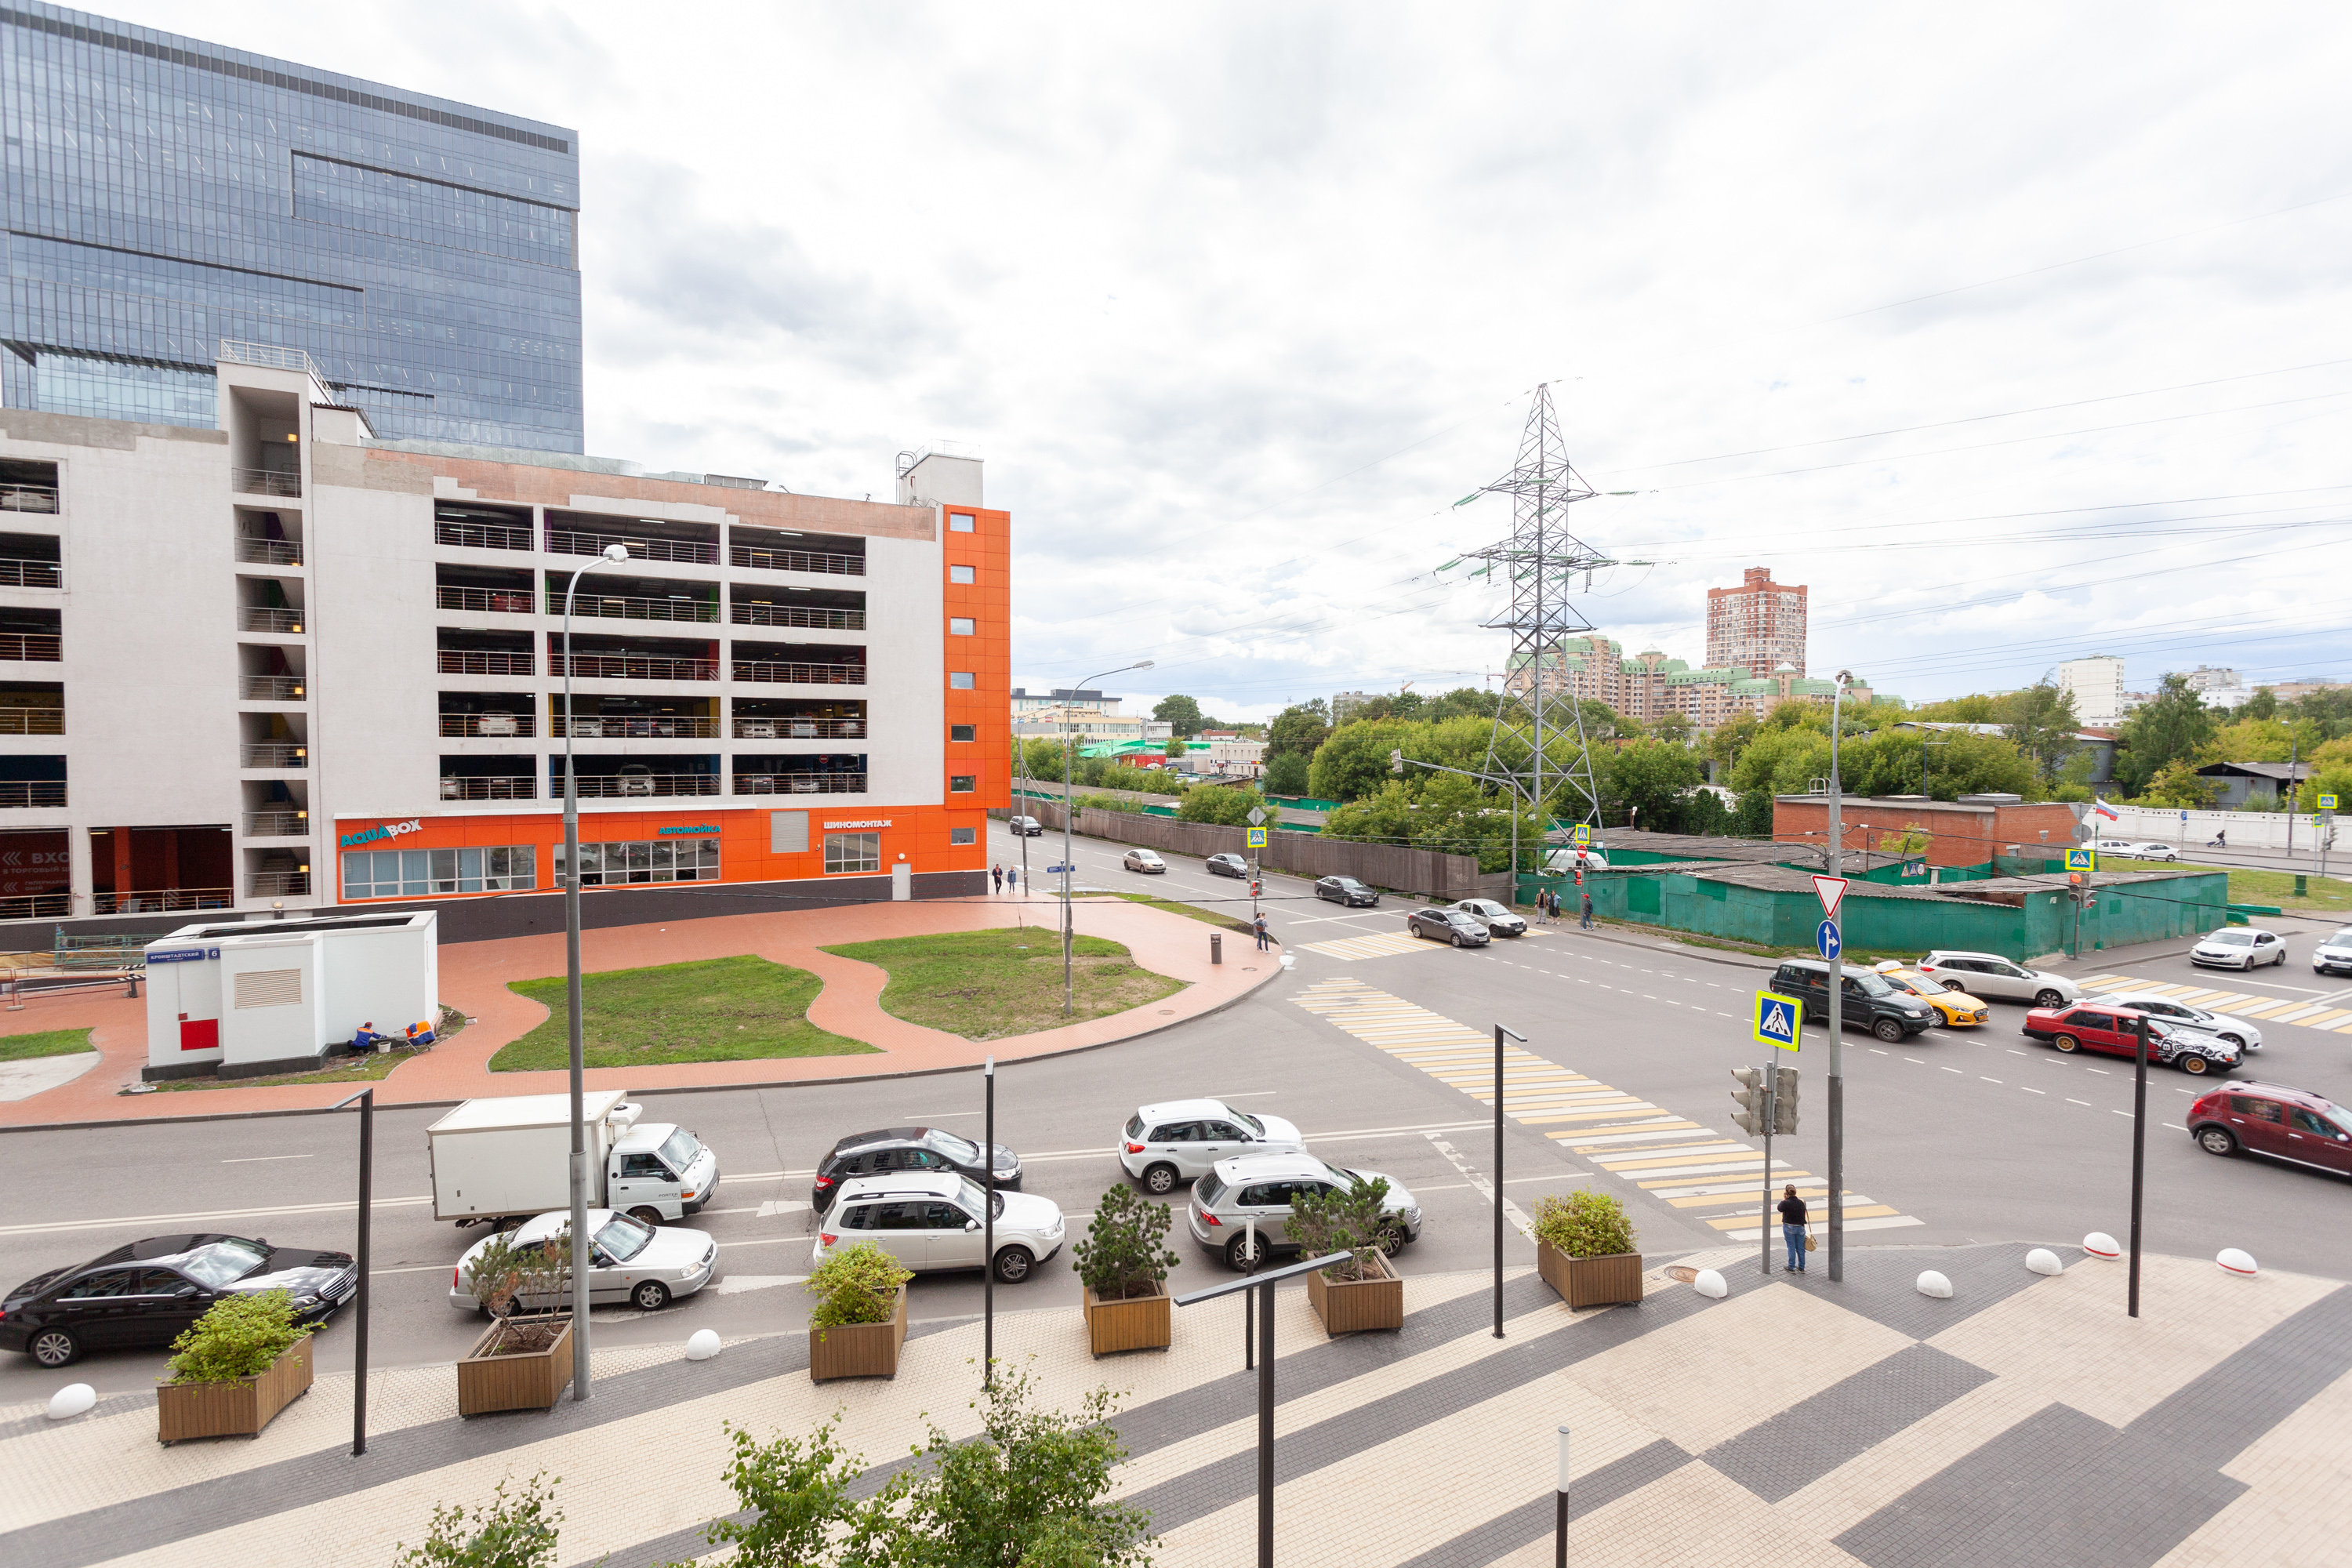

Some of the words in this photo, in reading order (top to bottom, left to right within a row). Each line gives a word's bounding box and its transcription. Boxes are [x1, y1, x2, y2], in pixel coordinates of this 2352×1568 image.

[659, 823, 720, 834] АВТОМОЙКА
[823, 820, 892, 829] ШИНОМОНТАЖ
[341, 819, 423, 848] AQUABOX
